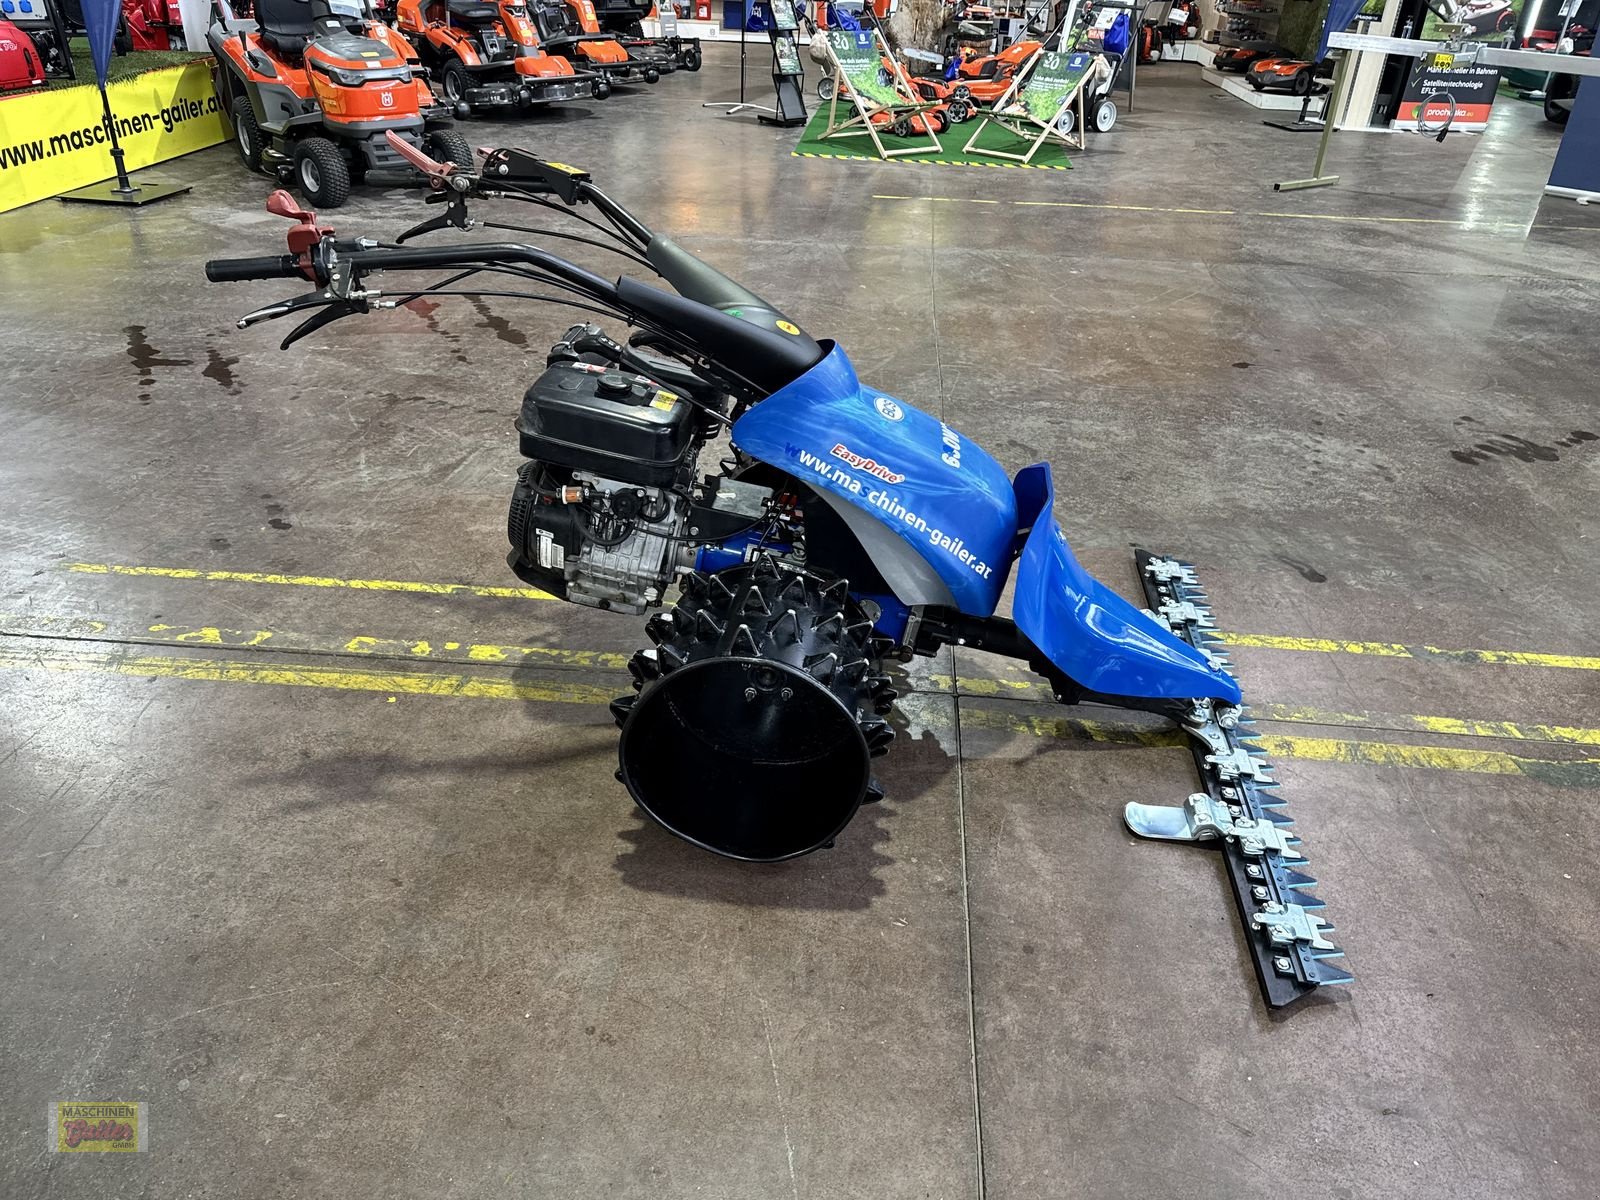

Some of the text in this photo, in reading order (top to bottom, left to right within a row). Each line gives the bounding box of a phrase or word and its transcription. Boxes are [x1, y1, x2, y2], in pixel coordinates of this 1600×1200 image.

[1475, 67, 1498, 76] Bahnen
[1426, 108, 1474, 118] prochka.eu
[784, 442, 993, 580] www.maschinen-gailer.at
